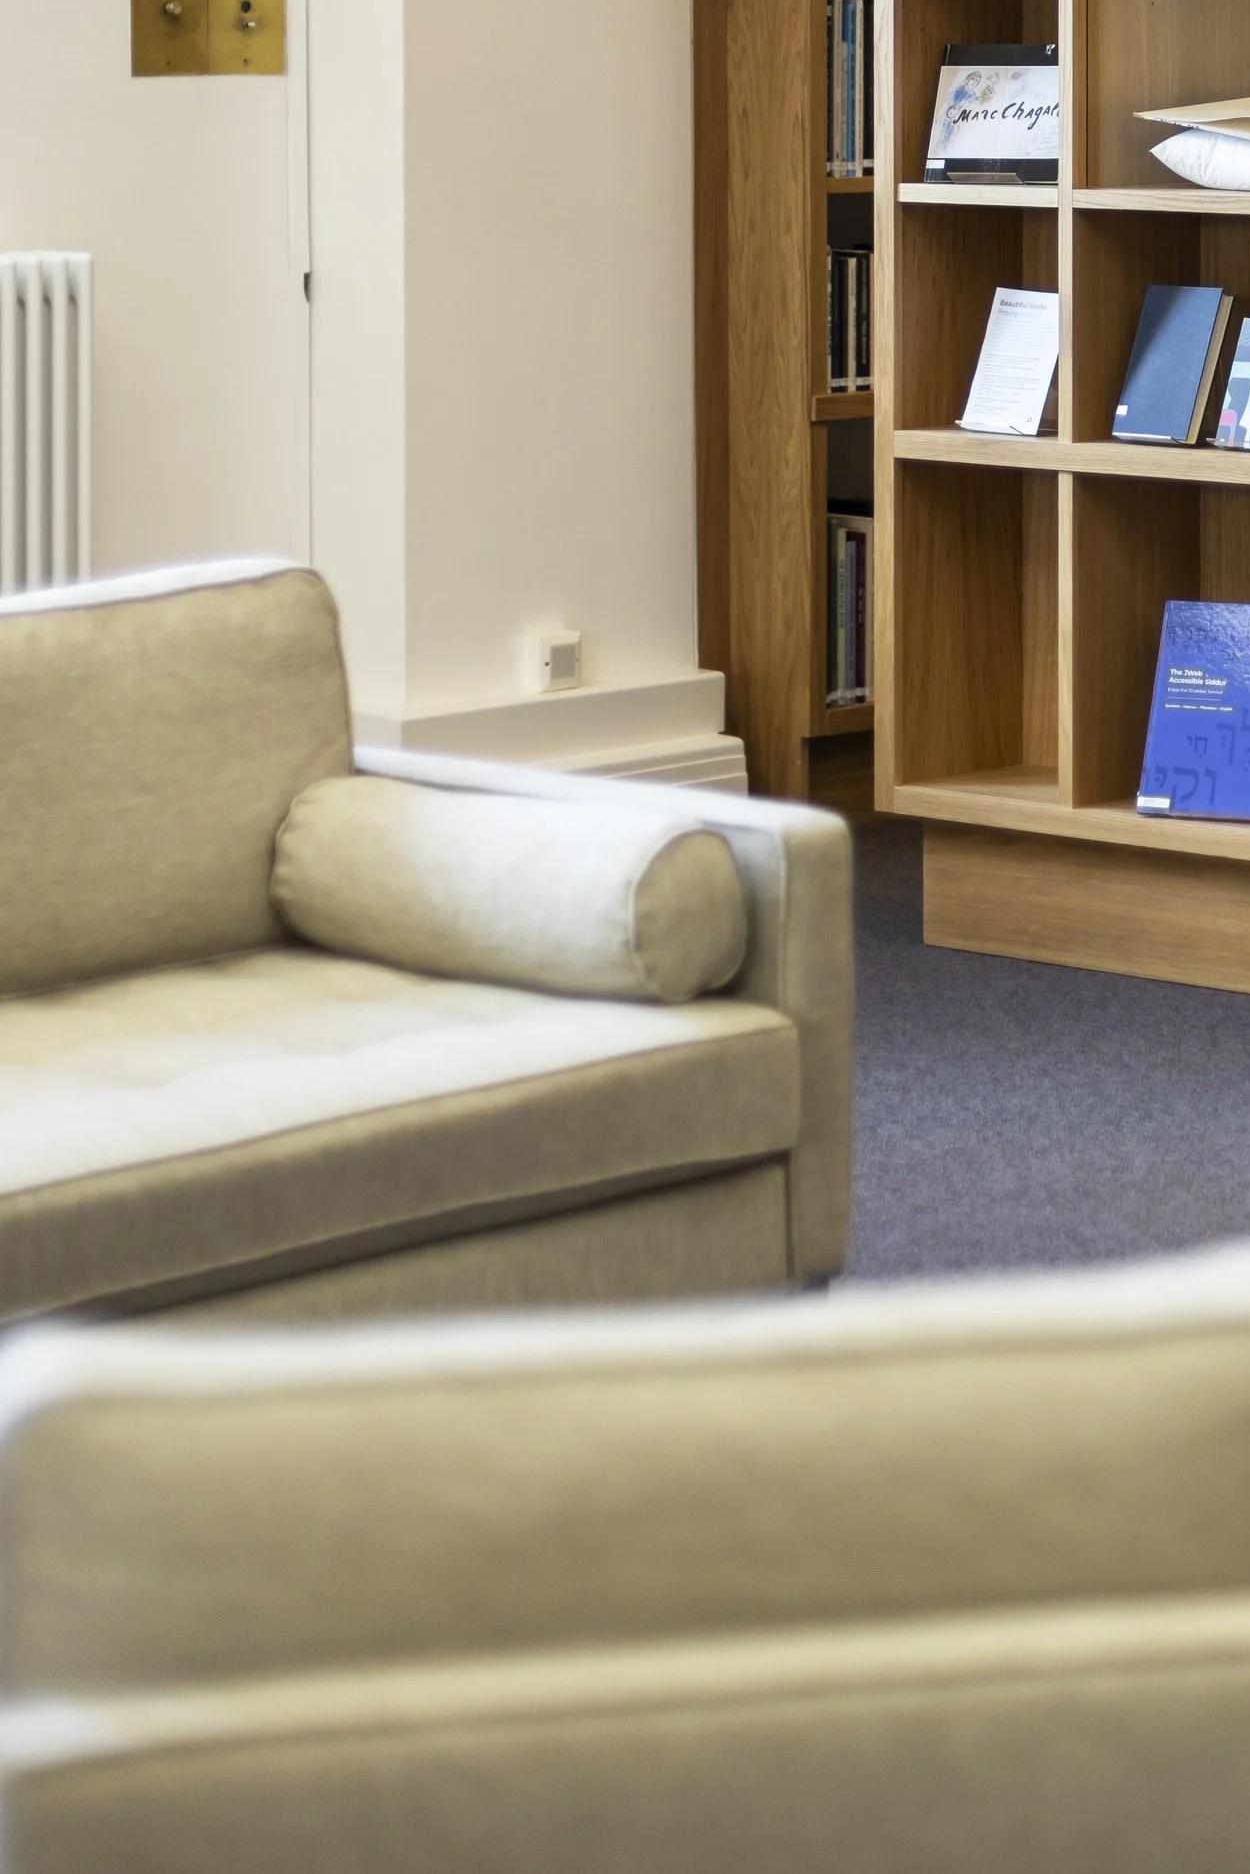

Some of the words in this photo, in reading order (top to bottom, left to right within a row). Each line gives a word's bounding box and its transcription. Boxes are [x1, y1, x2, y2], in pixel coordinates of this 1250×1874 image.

[1000, 299, 1029, 309] Beautiful
[1029, 303, 1047, 311] Books
[1170, 668, 1182, 676] The
[1183, 669, 1203, 677] JWeb
[1168, 677, 1203, 685] Accessible
[1204, 678, 1227, 686] Siddur
